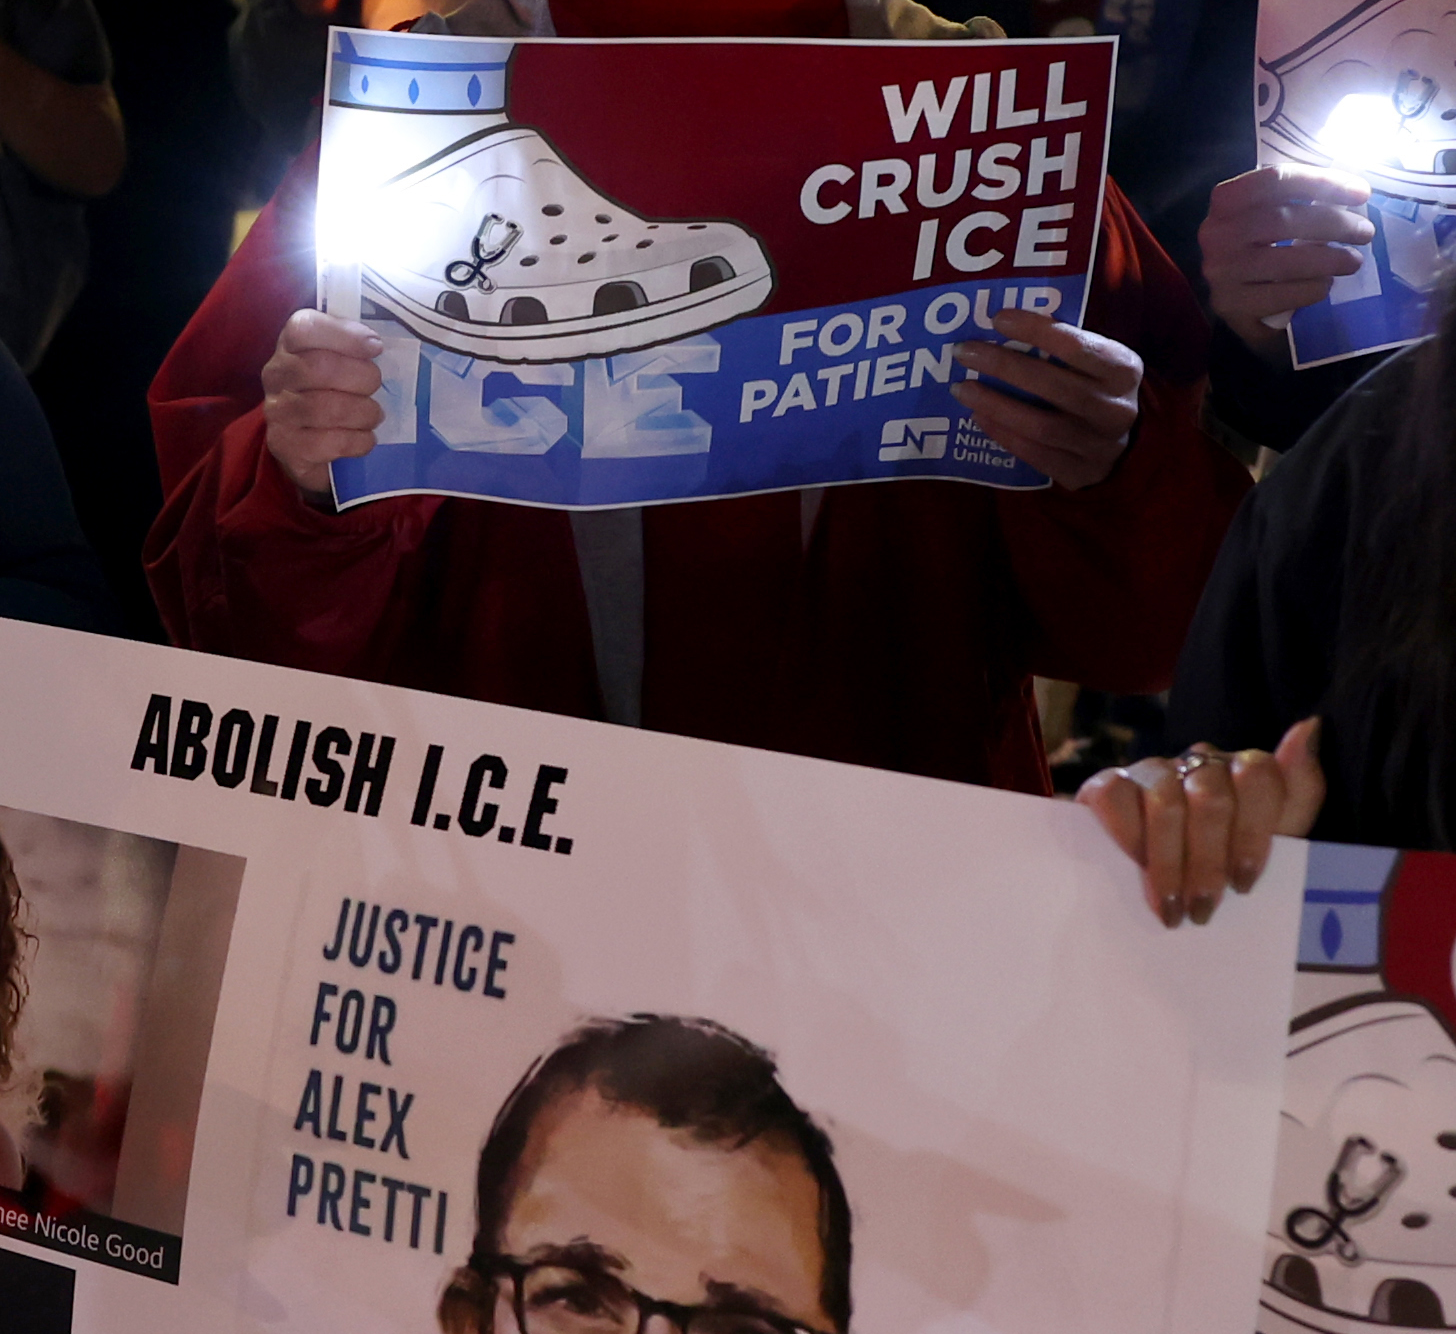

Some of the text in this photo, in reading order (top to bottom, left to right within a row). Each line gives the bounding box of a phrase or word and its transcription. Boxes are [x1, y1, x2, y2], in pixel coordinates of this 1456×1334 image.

[881, 61, 1088, 144] WILL
[799, 132, 1083, 225] CRUSH
[912, 203, 1076, 281] ICE
[778, 286, 1062, 366] FOR OUR
[738, 339, 1053, 424] PATIEN
[953, 448, 1016, 468] United
[129, 693, 578, 856] ABOLISH I.C.E.
[322, 896, 517, 1000] JUSTICE
[309, 982, 398, 1067] FOR
[293, 1069, 415, 1163] ALEX
[33, 1204, 101, 1255] Nicole
[105, 1225, 166, 1273] Good
[286, 1151, 449, 1257] PRETTI
